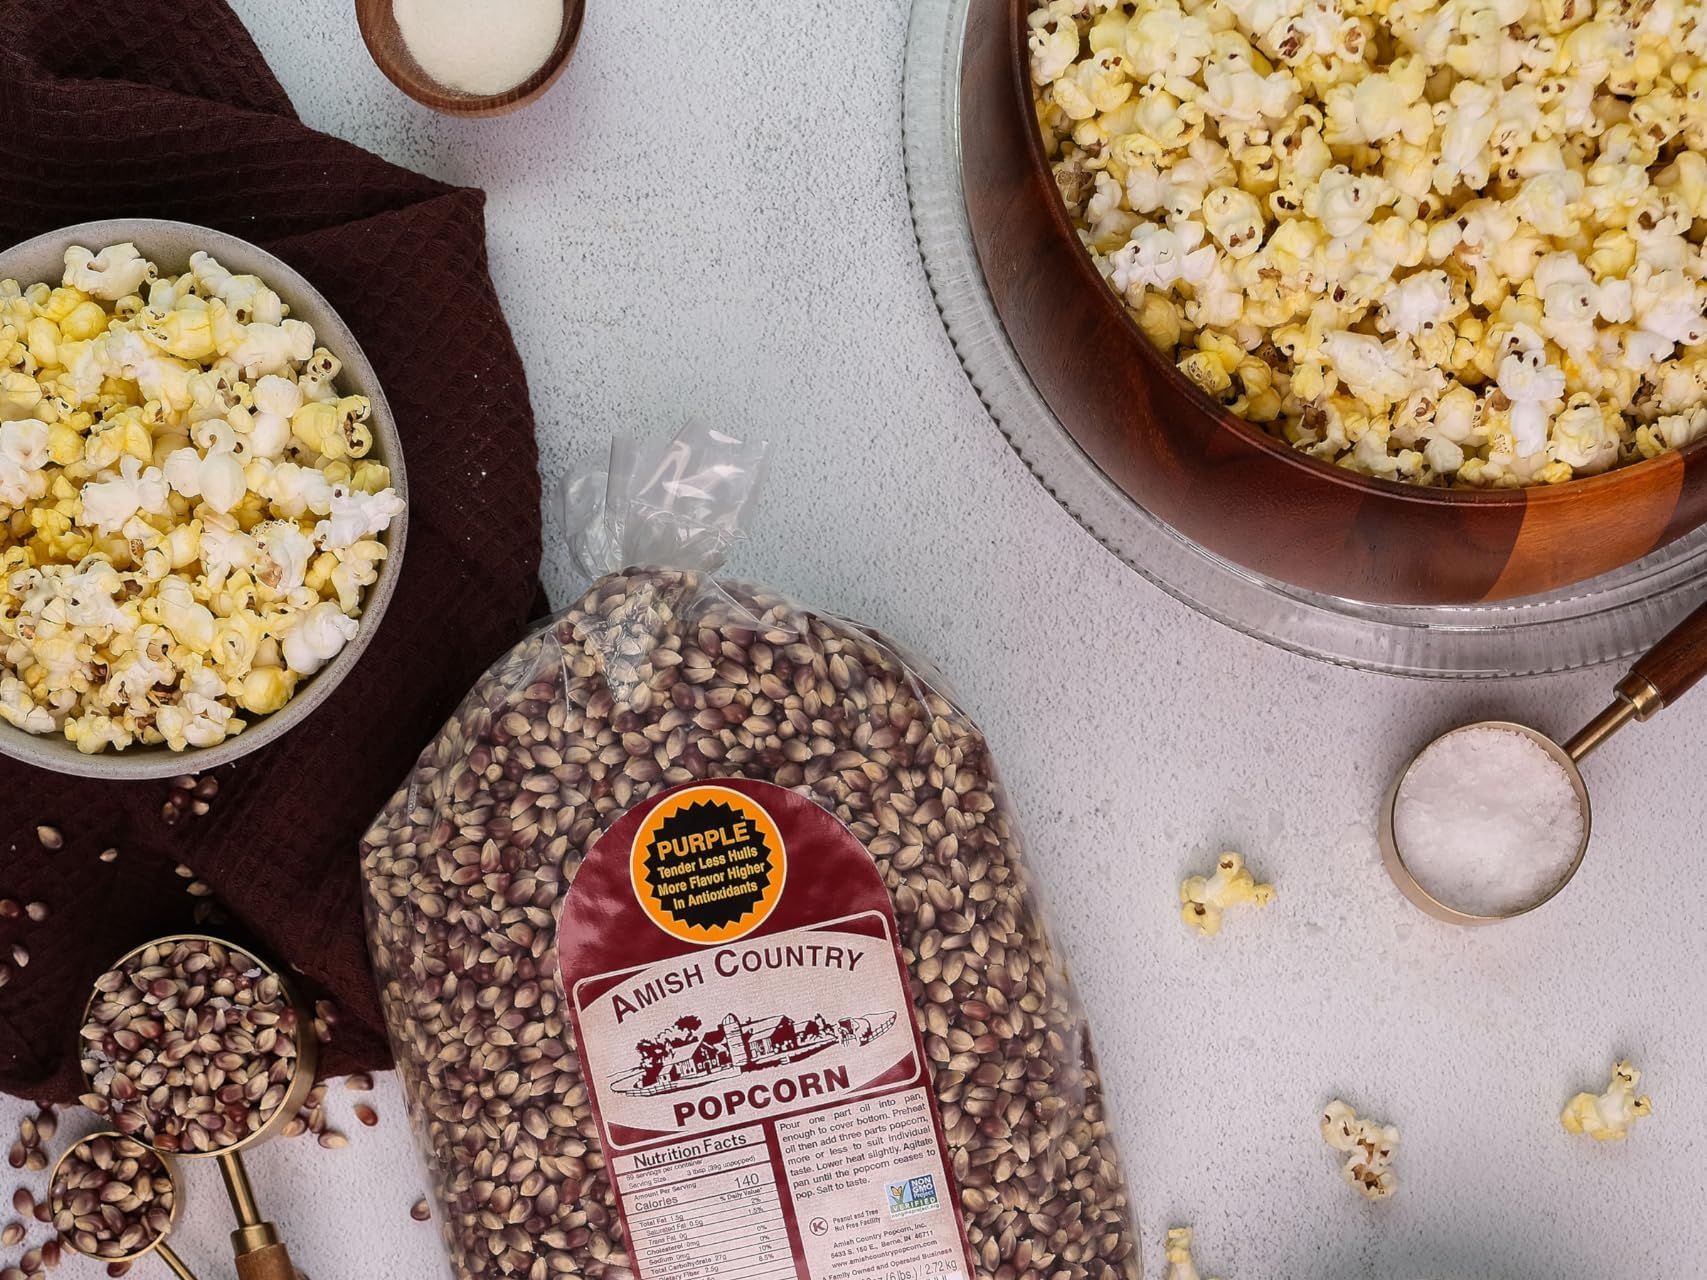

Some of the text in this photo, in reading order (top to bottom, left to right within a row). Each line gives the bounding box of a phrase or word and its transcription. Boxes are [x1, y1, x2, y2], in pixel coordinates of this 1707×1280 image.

[656, 821, 750, 861] PURPLE
[657, 846, 758, 879] Tender Less Hulls
[657, 862, 765, 897] More Flavor Higher
[673, 881, 758, 910] In Antioxidants
[611, 945, 864, 1024] AMISH COUNTRY
[673, 1065, 850, 1127] POPCORN
[779, 1093, 924, 1131] Pour one part oil into pan,
[782, 1102, 926, 1143] enough to cover bottom. Preheat
[785, 1115, 929, 1154] oil then add three parts popcorn,
[787, 1155, 811, 1166] more
[815, 1151, 825, 1159] or
[829, 1146, 848, 1156] less
[866, 1136, 884, 1147] suit
[888, 1125, 931, 1142] individual
[633, 1134, 747, 1169] Nutrition Facts
[789, 1138, 933, 1177] taste. Lower heat slightly. Agitate
[792, 1149, 936, 1190] pan until the popcorn ceases to
[911, 1176, 931, 1187] NON
[634, 1190, 659, 1201] Amount
[671, 1182, 697, 1192] Serving
[635, 1173, 760, 1212] Calories 140
[795, 1190, 815, 1201] pop.
[816, 1184, 834, 1195] Salt
[845, 1177, 870, 1188] taste.
[912, 1182, 933, 1194] GMO
[913, 1190, 934, 1199] Project
[832, 1214, 853, 1224] Peanut
[853, 1211, 865, 1219] and
[891, 1197, 938, 1213] VERIFIED
[833, 1222, 927, 1249] Amish Country Popcorn, Inc.
[834, 1217, 881, 1232] Nut Free Facility
[831, 1240, 938, 1268] www.amishcountrypopcorn.com
[851, 1265, 875, 1276] Owned
[876, 1262, 889, 1270] and
[890, 1254, 921, 1267] Operated
[921, 1247, 953, 1260] Business
[924, 1260, 945, 1275] 2.72
[944, 1259, 958, 1272] kg
